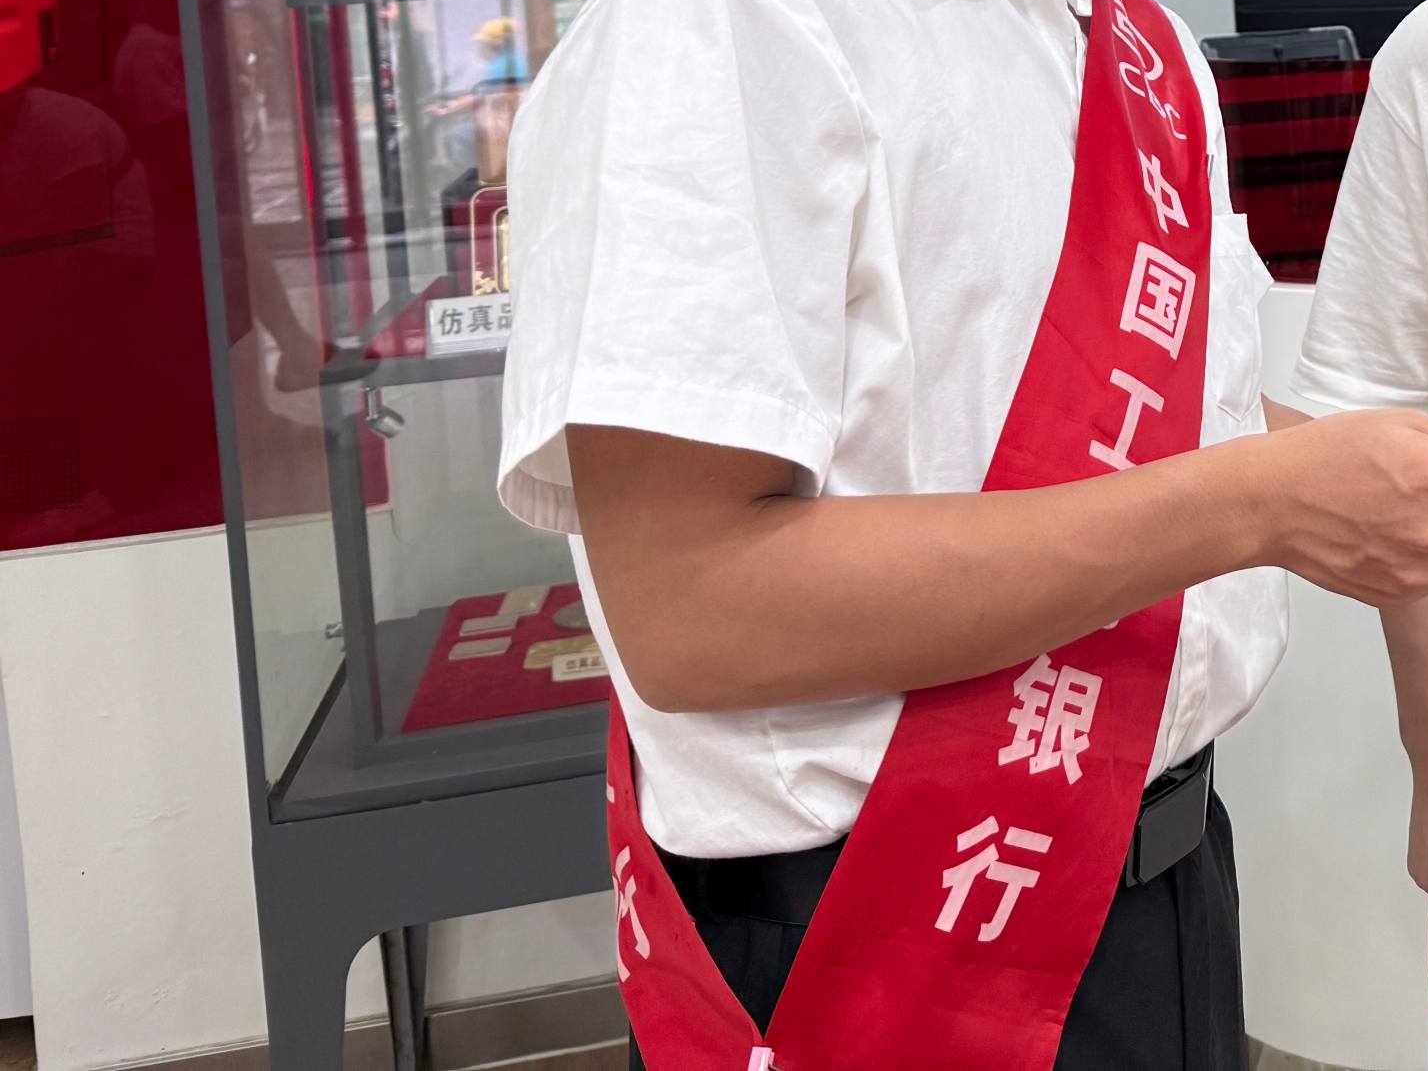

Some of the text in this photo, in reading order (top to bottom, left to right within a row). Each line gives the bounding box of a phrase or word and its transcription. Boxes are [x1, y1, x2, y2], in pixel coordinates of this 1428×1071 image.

[935, 147, 1197, 943] 中国工银行
